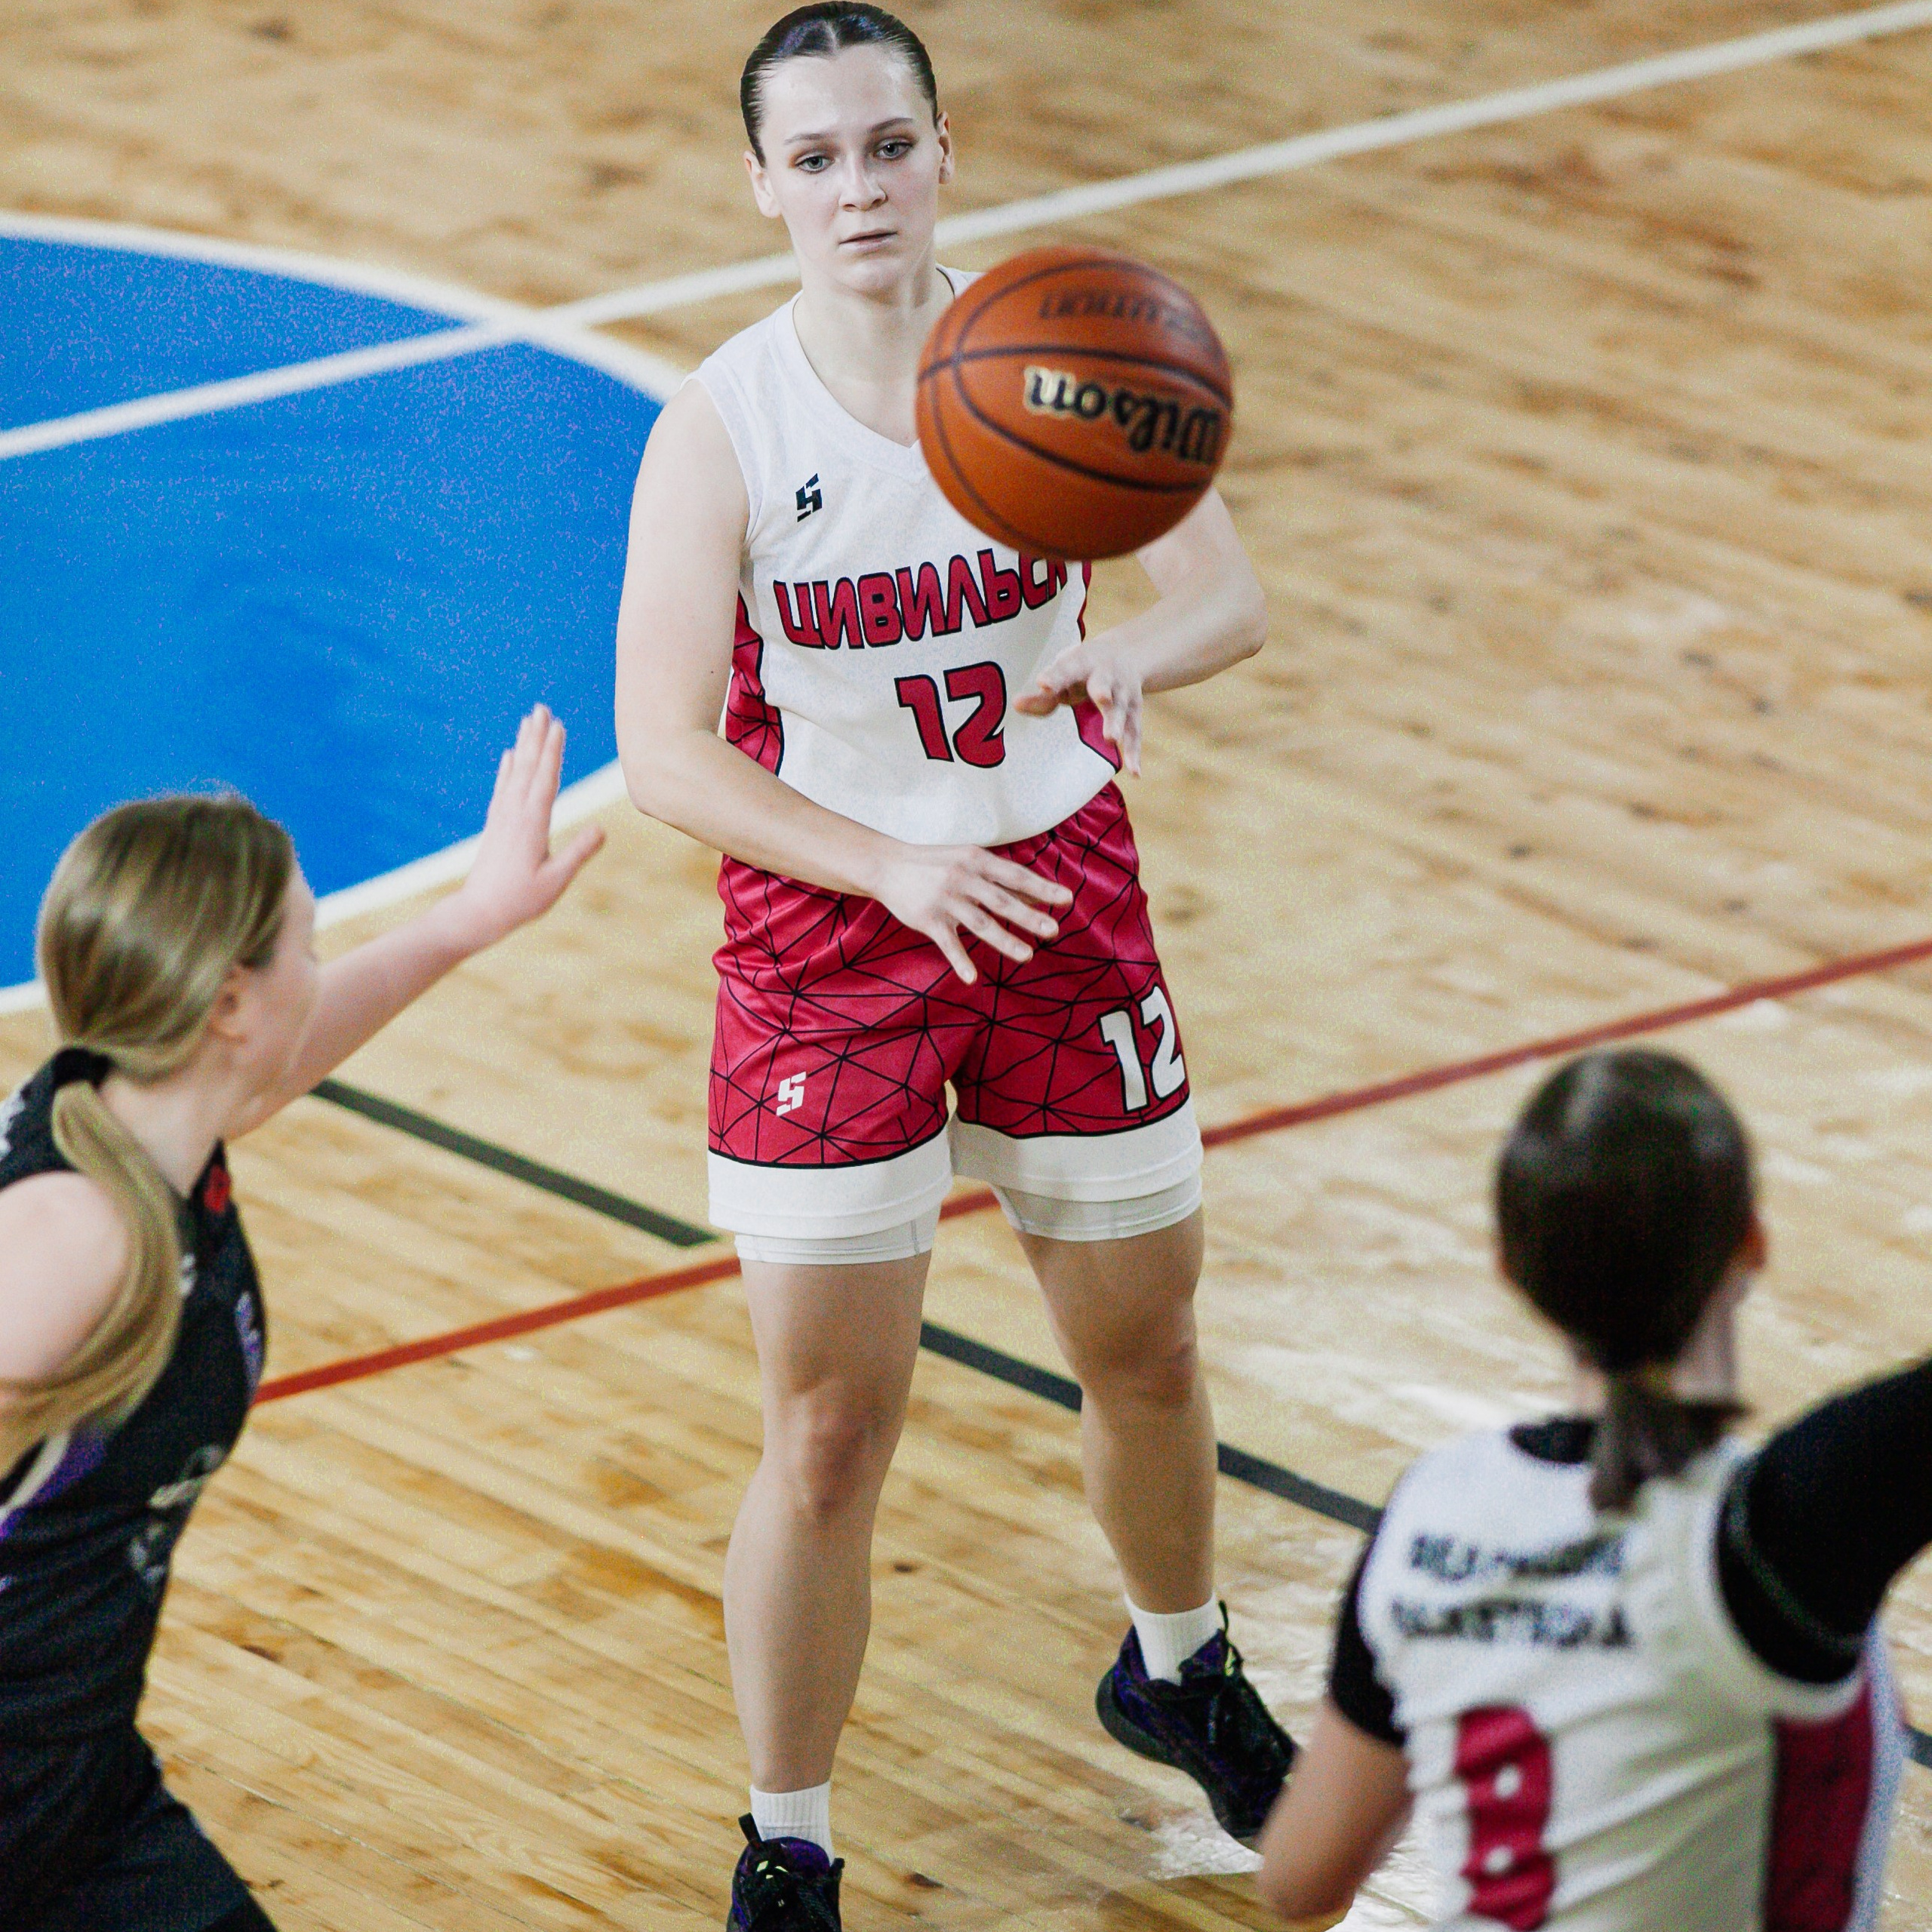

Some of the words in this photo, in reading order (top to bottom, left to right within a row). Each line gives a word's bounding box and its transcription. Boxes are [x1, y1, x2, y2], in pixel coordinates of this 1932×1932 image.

[1024, 366, 1221, 465] Wilson
[894, 661, 1008, 768] 12
[1097, 983, 1186, 1114] 12
